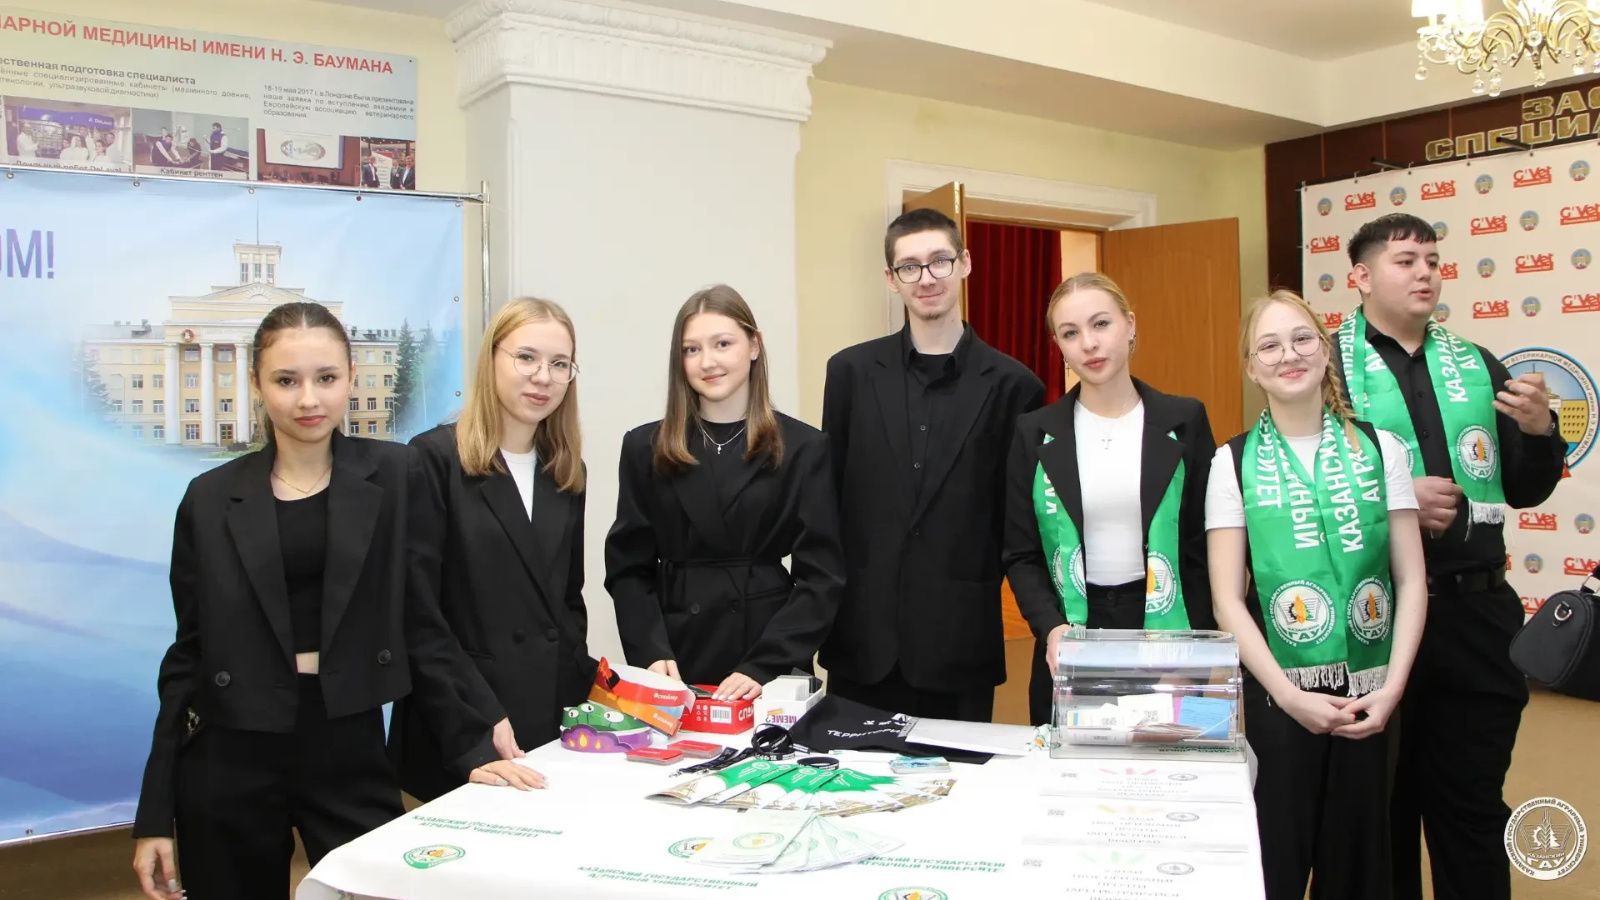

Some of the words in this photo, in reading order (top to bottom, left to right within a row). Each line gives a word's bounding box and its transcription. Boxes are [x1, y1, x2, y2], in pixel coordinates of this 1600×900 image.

[0, 15, 76, 38] АРНОЙ
[83, 25, 196, 52] МЕДИЦИНЫ
[203, 39, 266, 60] ИМЕНИ
[271, 48, 287, 62] Н.
[293, 51, 308, 65] Э.
[314, 53, 393, 74] БАУМАНА
[60, 63, 125, 80] подготовка
[126, 70, 196, 86] специалиста
[1425, 112, 1600, 161] СПЕЦИ
[0, 229, 54, 279] М!
